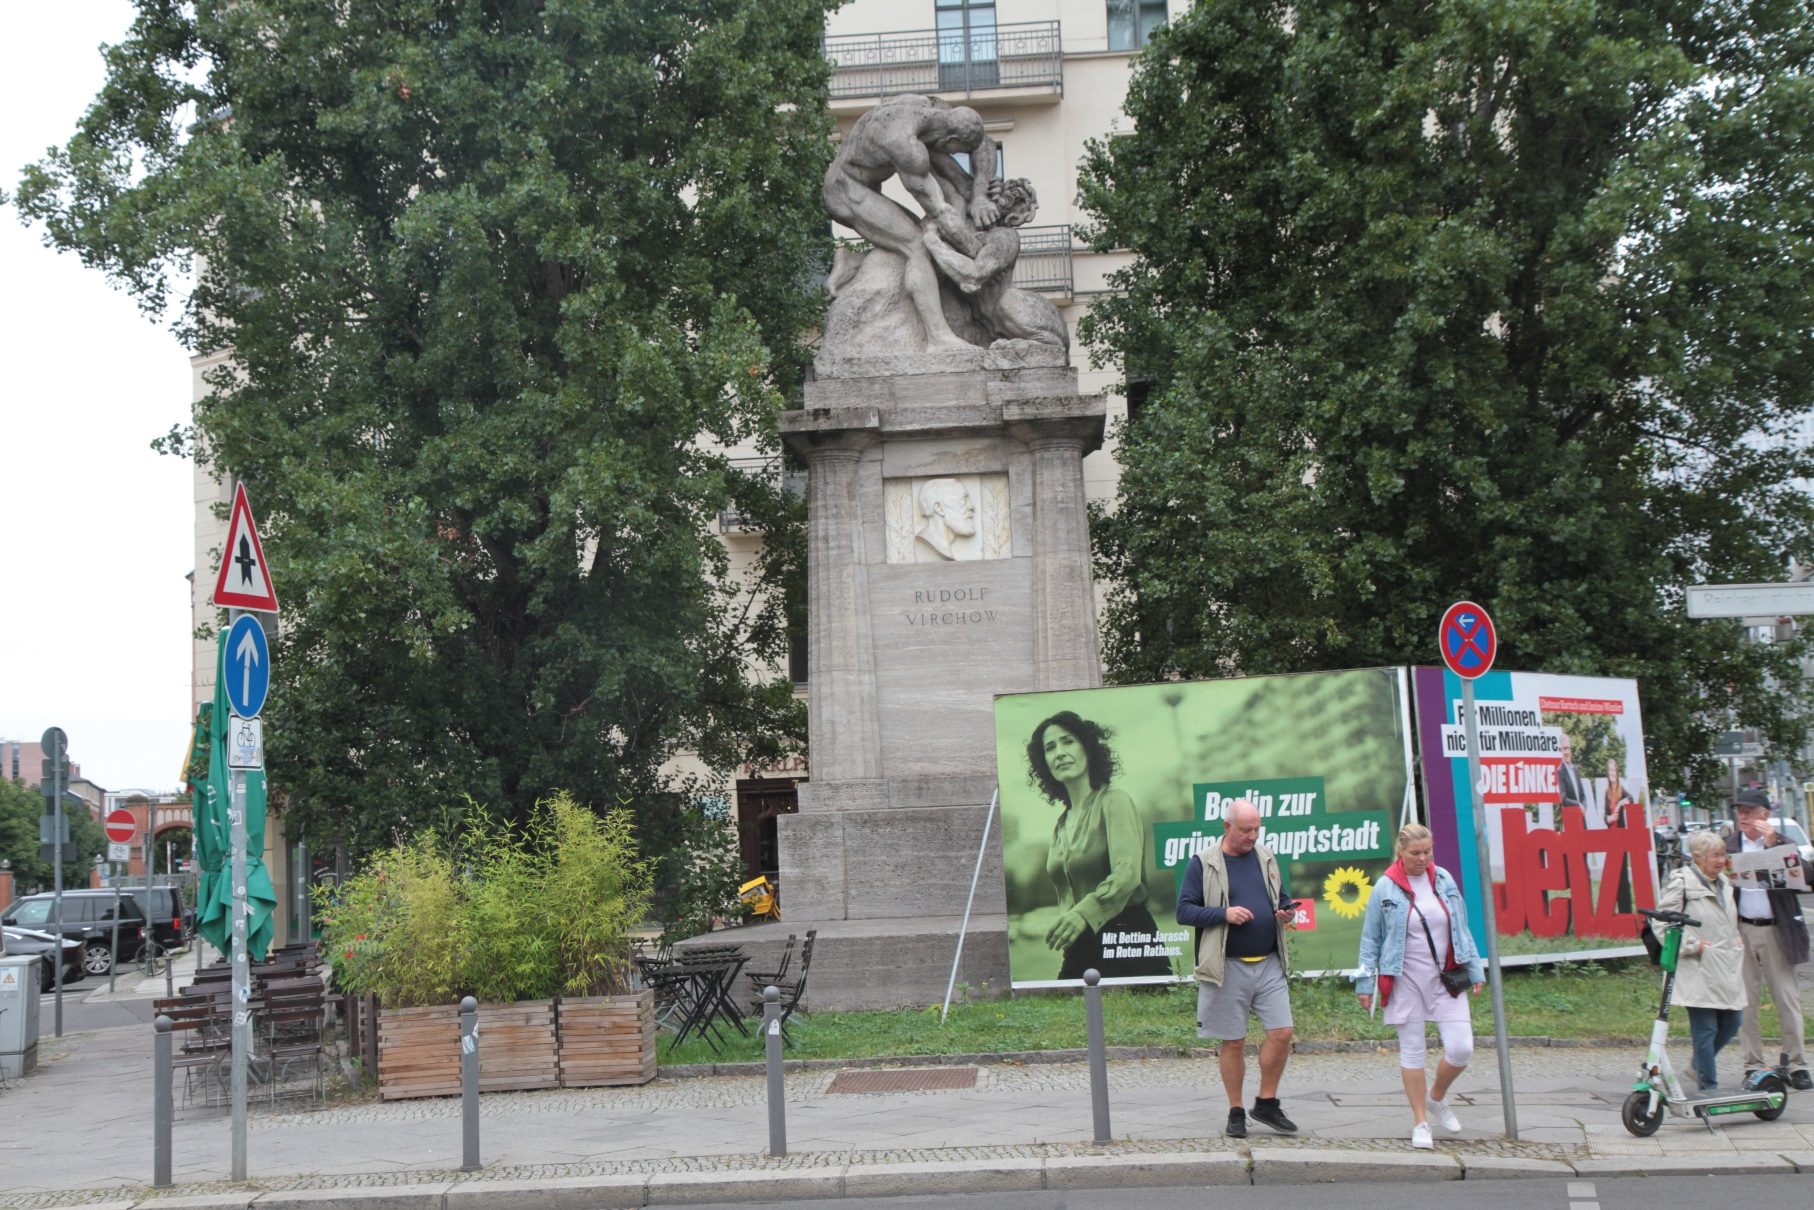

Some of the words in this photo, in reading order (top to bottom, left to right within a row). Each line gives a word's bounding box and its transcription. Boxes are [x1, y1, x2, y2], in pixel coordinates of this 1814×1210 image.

[915, 587, 991, 604] RUDOLF
[906, 610, 998, 626] VIRCHOW
[1479, 705, 1540, 729] Millionen,
[1479, 731, 1497, 751] für
[1498, 731, 1561, 752] Millionäre.
[1480, 764, 1506, 794] DIE
[1204, 789, 1273, 821] Bein
[1278, 791, 1317, 817] zur
[1163, 831, 1222, 867] grün
[1492, 803, 1656, 939] Jetzt
[1102, 932, 1118, 945] Mit
[1119, 931, 1151, 944] Bettina
[1152, 929, 1190, 942] Jarasch
[1103, 947, 1115, 959] im
[1116, 946, 1142, 958] Roten
[1143, 944, 1183, 957] Rathaus.
